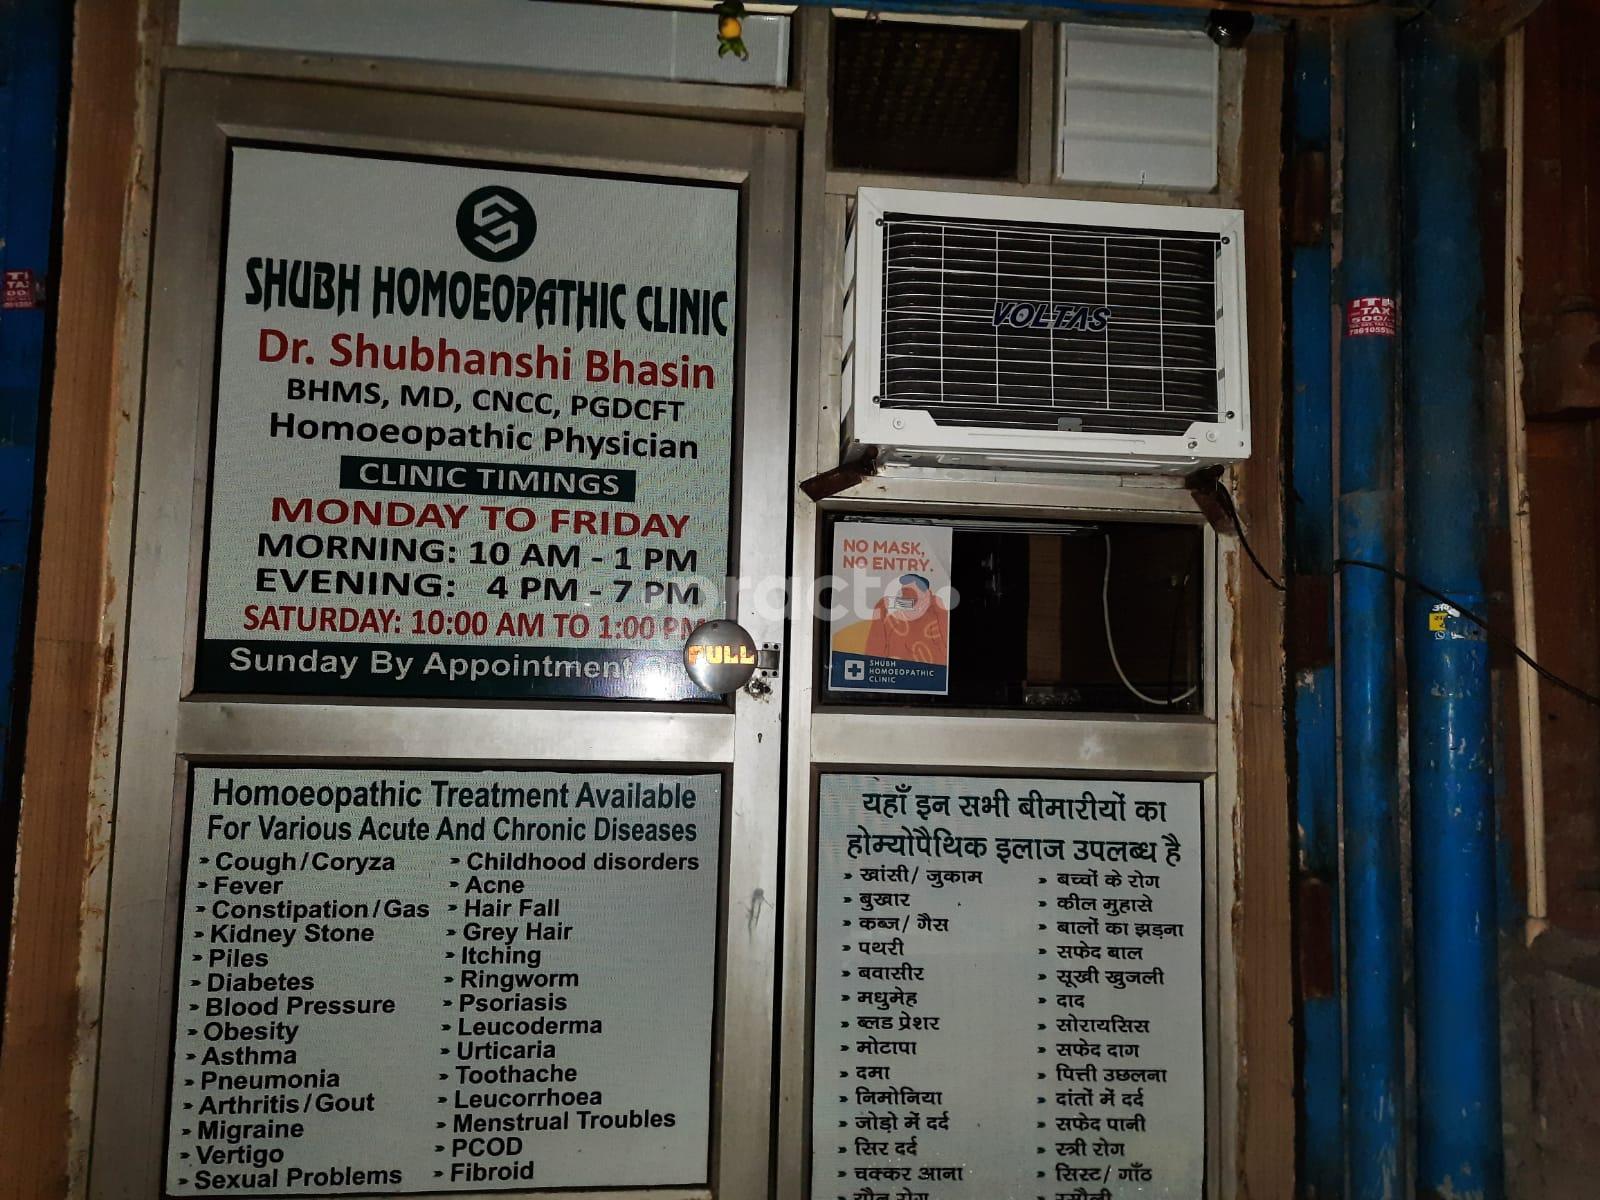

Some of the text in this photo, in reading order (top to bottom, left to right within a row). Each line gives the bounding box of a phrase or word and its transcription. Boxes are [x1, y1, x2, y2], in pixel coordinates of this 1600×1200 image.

[246, 257, 727, 336] SHUBH HOMOEOPATHIC CLINIC
[992, 302, 1111, 332] VOLTAS
[1361, 307, 1390, 316] TAX
[259, 329, 714, 389] Dr. Shubhanshi Bhasin
[288, 379, 685, 421] BHMS, MD, CNCC, PGDCFT
[271, 412, 697, 460] Homoeopathic Physician
[360, 463, 619, 495] CLINIC TIMINGS
[272, 497, 690, 538] MONDAY TO FRIDAY
[258, 533, 455, 563] MORNING:
[470, 541, 510, 565] 10
[521, 544, 580, 568] AM
[615, 547, 631, 570] 1
[645, 548, 697, 572] PM
[844, 539, 925, 557] NO MASK,
[843, 556, 934, 572] NO ENTRY.
[257, 568, 454, 597] EVENING:
[487, 576, 508, 599] 4
[521, 577, 577, 601] PM
[613, 580, 632, 602] 7
[645, 581, 699, 606] PM
[244, 605, 400, 633] SATURDAY:
[412, 610, 487, 636] 10:00
[496, 612, 544, 637] AM
[553, 613, 589, 638] TO
[599, 615, 654, 639] 1:00
[229, 647, 358, 679] Sunday
[370, 651, 414, 680] By
[423, 652, 632, 681] Appointment
[869, 668, 934, 677] HOMOEOPATHIC
[869, 676, 896, 684] CLINIC
[213, 778, 696, 813] Homoeopathic Treatment Available
[862, 784, 1166, 822] यहाँ इन सभी बीमारीयों का
[208, 815, 697, 841] For Various Acute And Chronic Diseases
[847, 825, 1181, 867] होम्योपैथिक इलाज उपलब्ध है
[467, 852, 699, 870] Childhood disorders
[214, 876, 283, 895] Fever
[465, 876, 524, 893] Acne
[926, 870, 982, 888] जुकाम
[1057, 868, 1159, 888] बच्चों के रोग
[465, 899, 559, 917] Hair Fall
[859, 893, 910, 911] बुखार
[1057, 893, 1152, 917] कील मुहासे
[917, 913, 949, 931] गैस
[1057, 916, 1099, 935] बालों
[1105, 922, 1128, 935] का
[211, 924, 374, 947] Kidney Stone
[463, 922, 573, 945] Grey Hair
[858, 937, 904, 956] पथरी
[1057, 941, 1143, 960] सफेद बाल
[210, 949, 268, 967] Piles
[462, 946, 540, 968] Itching
[461, 970, 578, 992] Ringworm
[858, 962, 924, 980] बवासीर
[1057, 965, 1164, 989] सूखी खुजली
[208, 973, 314, 992] Diabetes
[206, 996, 395, 1016] Blood Pressure
[460, 993, 567, 1012] Psoriasis
[858, 986, 917, 1010] मधुमेह
[1056, 995, 1085, 1008] दाद
[459, 1016, 602, 1036] Leucoderma
[857, 1011, 940, 1031] ब्लड प्रेशर
[1056, 1013, 1149, 1033] सोरायसिस
[204, 1021, 299, 1044] Obesity
[201, 1046, 296, 1065] Asthma
[458, 1040, 555, 1060] Urticaria
[856, 1036, 916, 1055] मोटापा
[1056, 1038, 1139, 1057] सफेद दाग
[202, 1069, 339, 1090] Pneumonia
[455, 1064, 577, 1084] Toothache
[856, 1066, 890, 1080] दमा
[1056, 1063, 1167, 1082] पित्ती उछलना
[455, 1088, 602, 1108] Leucorrhoea
[855, 1086, 942, 1105] निमोनिया
[1056, 1087, 1143, 1107] दांतों में दर्द
[454, 1109, 675, 1133] Menstrual Troubles
[904, 1111, 920, 1130] में
[926, 1111, 949, 1130] दर्द
[1056, 1112, 1146, 1132] सफेद पानी
[198, 1119, 304, 1144] Migraine
[452, 1137, 522, 1157] PCOD
[855, 1136, 917, 1156] सिर दर्द
[1055, 1137, 1125, 1156] स्त्री रोग
[196, 1145, 284, 1168] Vertigo
[195, 1167, 402, 1190] Sexual Problems
[451, 1161, 534, 1182] Fibroid
[854, 1167, 963, 1181] चक्कर आना
[1118, 1162, 1152, 1181] गाँठ
